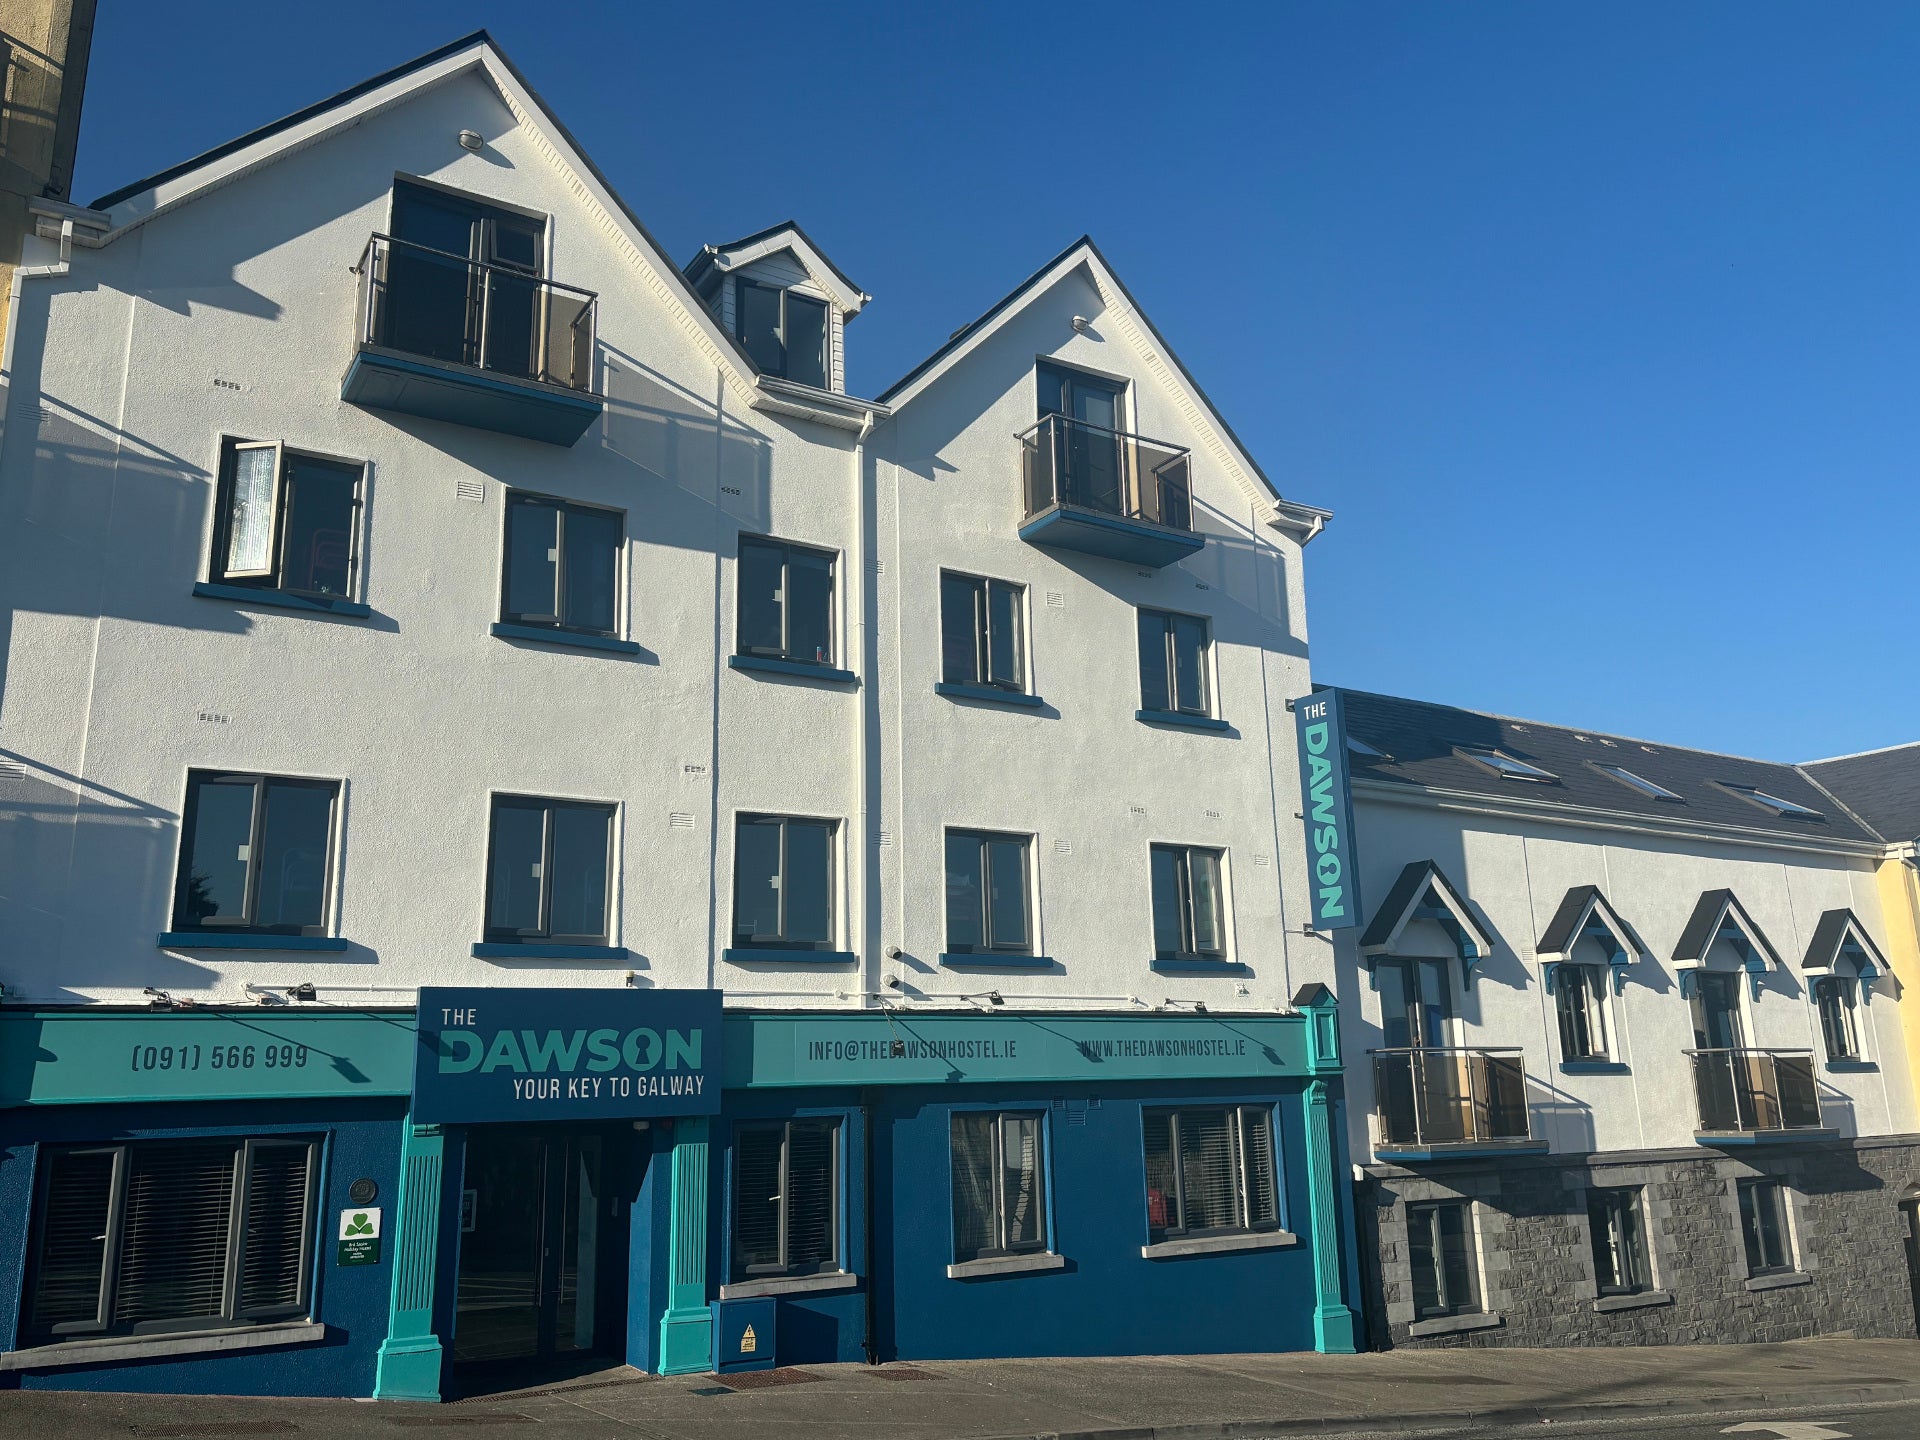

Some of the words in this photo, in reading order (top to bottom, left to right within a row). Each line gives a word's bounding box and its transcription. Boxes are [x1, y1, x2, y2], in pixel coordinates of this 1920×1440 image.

[1304, 701, 1327, 720] THE
[1305, 721, 1345, 919] DAWSON
[441, 1008, 477, 1026] THE
[131, 1044, 201, 1071] (091)
[211, 1045, 256, 1069] 566
[264, 1045, 308, 1068] 999
[438, 1027, 703, 1074] DAWSON
[1081, 1039, 1246, 1057] WWW.THEDAWSONHOSTEL.IE
[513, 1078, 560, 1100] YOUR
[568, 1077, 602, 1099] KEY
[609, 1077, 630, 1097] TO
[637, 1075, 705, 1097] GALWAY
